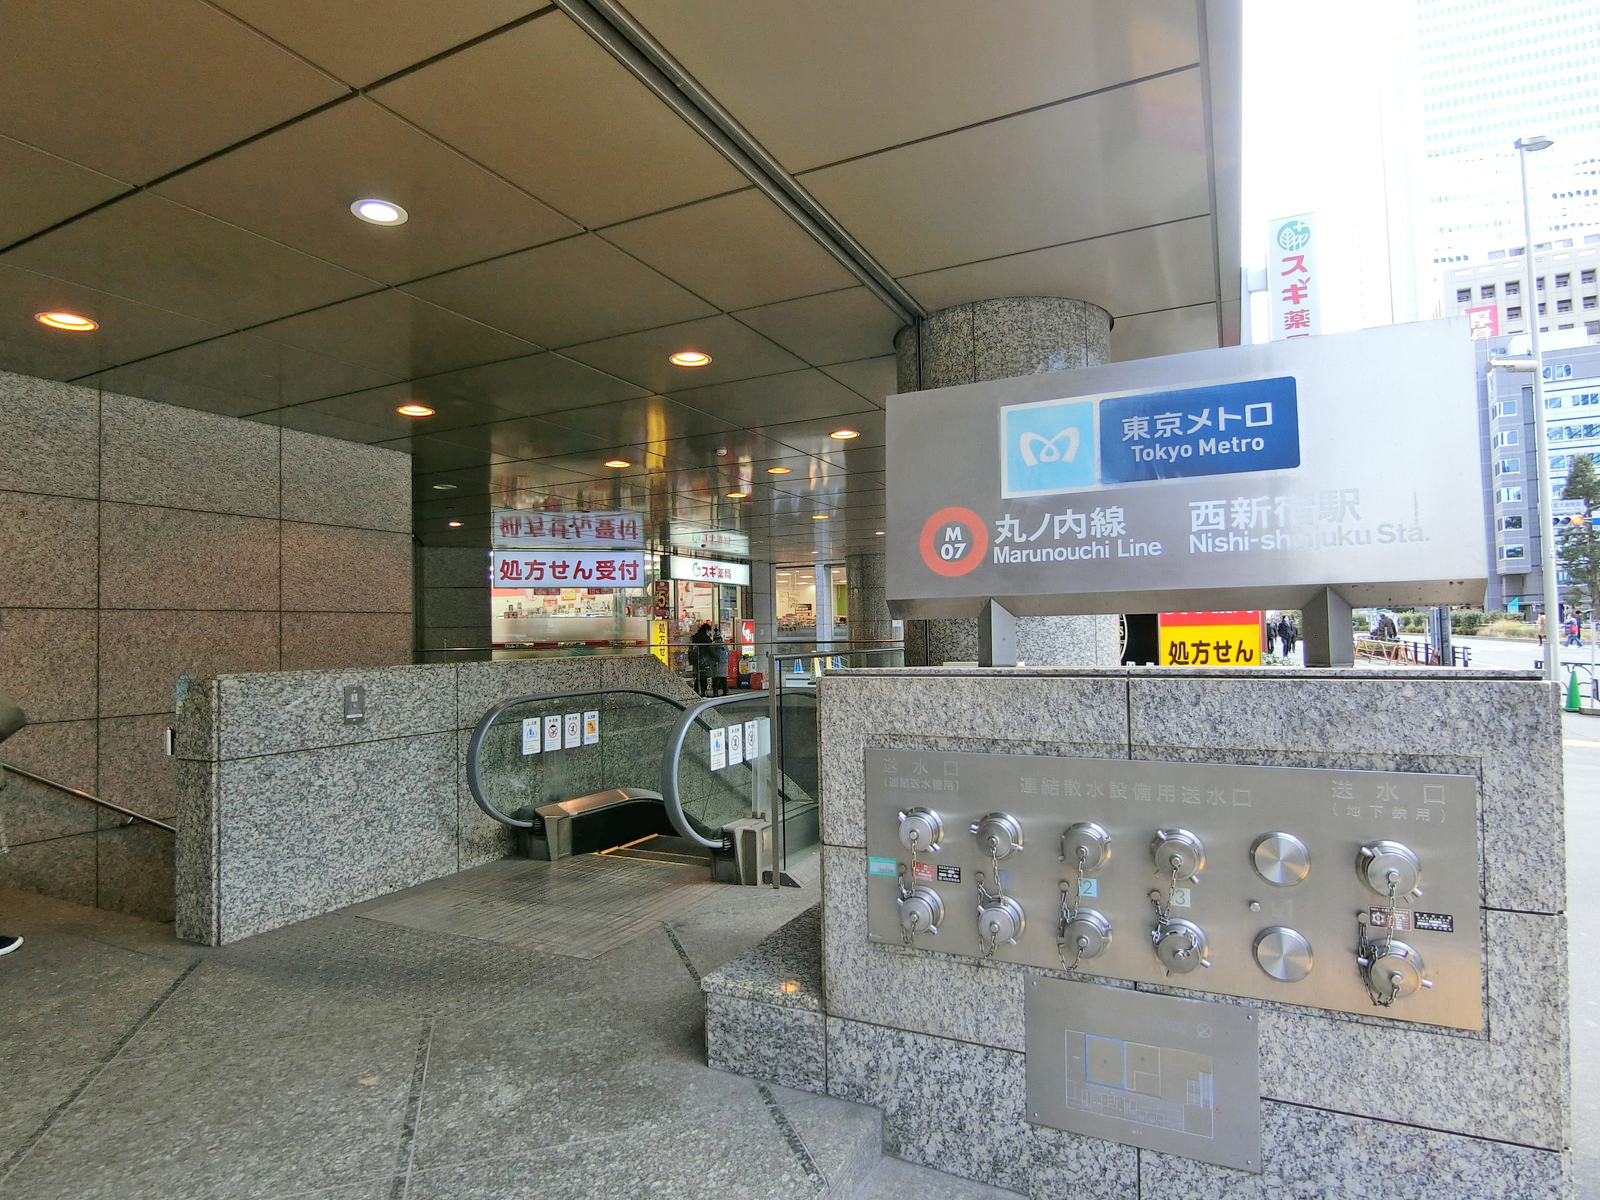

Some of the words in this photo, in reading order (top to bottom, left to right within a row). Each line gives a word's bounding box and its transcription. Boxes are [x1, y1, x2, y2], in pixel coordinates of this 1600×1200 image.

[1281, 254, 1311, 339] スギ薬
[1121, 401, 1274, 442] 東京メトロ
[1131, 443, 1192, 463] Tokyo
[1199, 436, 1265, 458] Metro
[993, 505, 1127, 545] 丸ノ内線
[1188, 488, 1362, 532] 西新宿駅
[943, 526, 962, 542] M
[993, 538, 1109, 566] Marunouchi
[1116, 538, 1163, 559] Line
[1189, 524, 1370, 554] Nishi-shjuku
[1376, 522, 1431, 545] Sta.
[941, 542, 967, 560] 07
[499, 559, 640, 582] 処方せん受付
[701, 564, 732, 580] スギ薬局
[1168, 640, 1254, 666] 処方せん
[883, 756, 959, 777] 送水口
[1020, 776, 1252, 808] 連結散水設備用送水口
[1331, 779, 1446, 805] 送水口
[1332, 802, 1447, 824] (地下鉄用)
[1083, 881, 1093, 895] 2
[1175, 890, 1186, 905] 3
